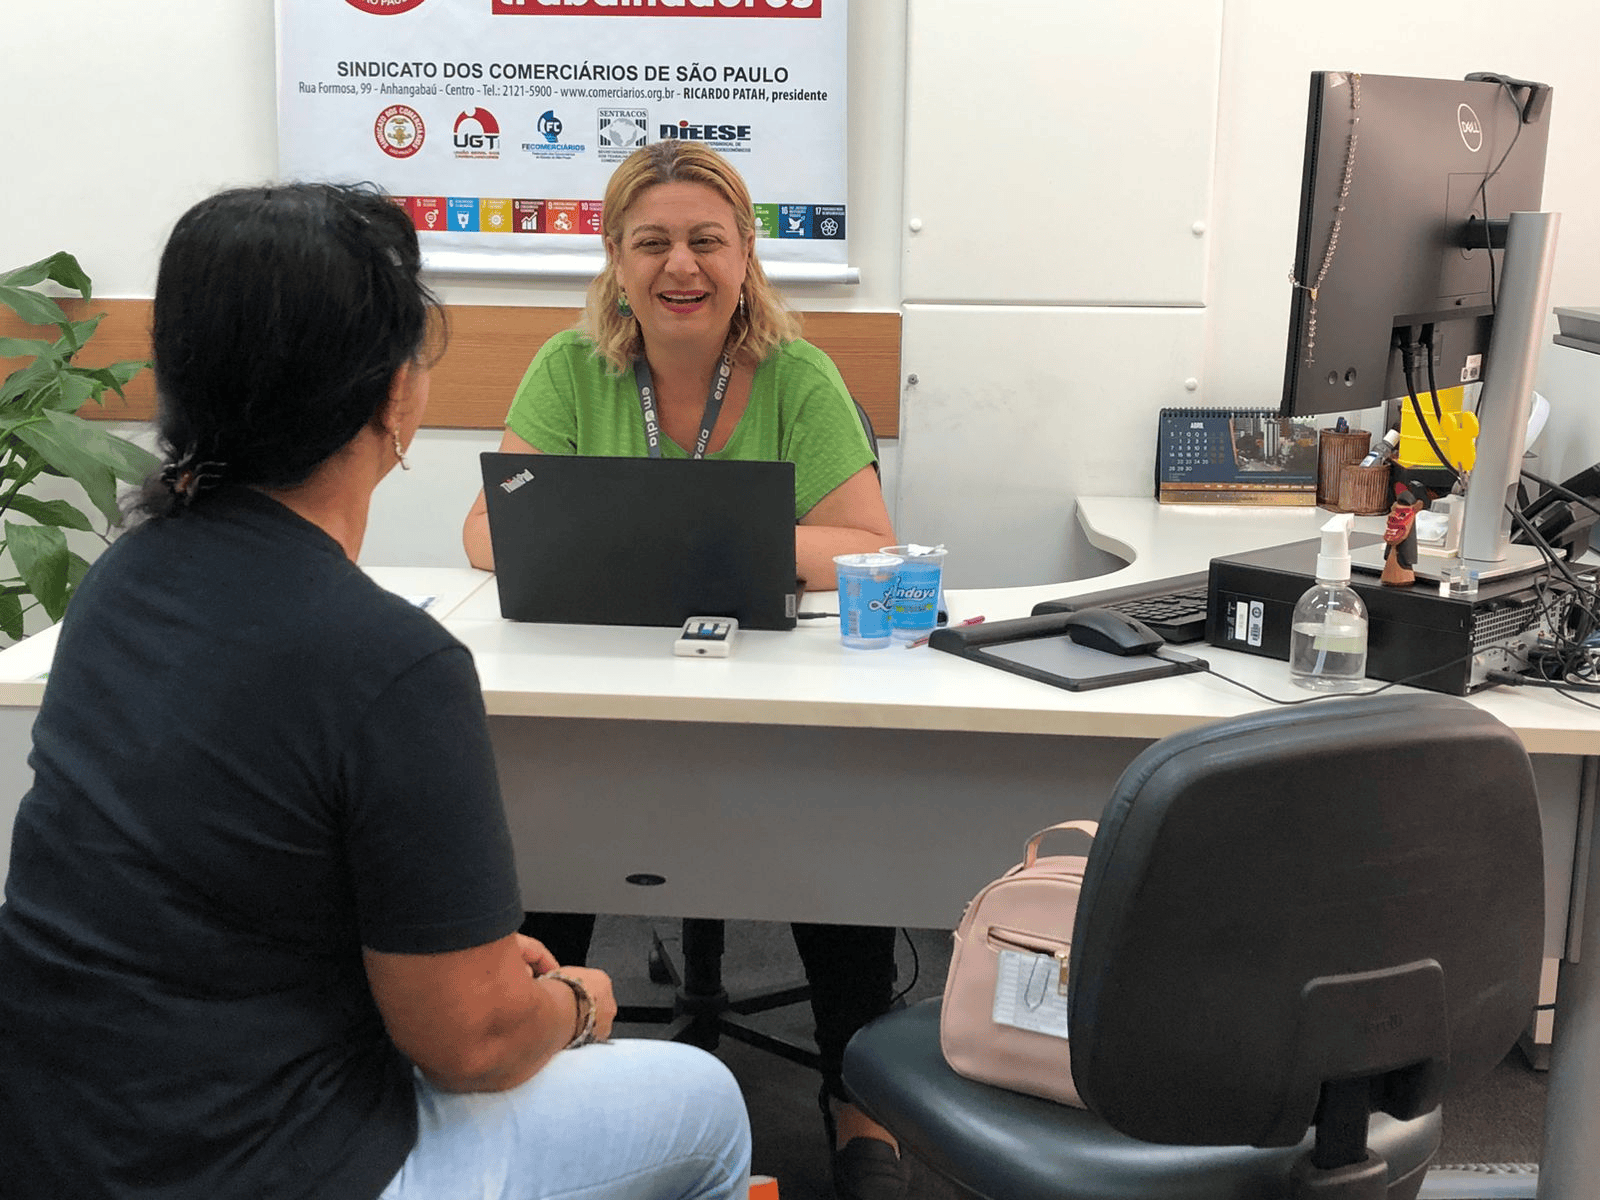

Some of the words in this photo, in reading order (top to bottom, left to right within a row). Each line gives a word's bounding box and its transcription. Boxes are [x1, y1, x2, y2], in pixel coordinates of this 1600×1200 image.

[337, 61, 437, 78] SINDICATO
[443, 62, 483, 79] DOS
[489, 61, 639, 81] COMERCIÁRIOS
[645, 66, 670, 81] DE
[676, 62, 717, 82] SÃO
[723, 67, 789, 83] PAULO
[298, 81, 316, 94] Rua
[318, 82, 359, 96] Formosa,
[360, 82, 372, 94] 99
[380, 82, 438, 98] Anhangabaú
[445, 83, 474, 96] Centro
[483, 84, 501, 96] Tel.:
[502, 84, 552, 97] 2121-5900
[560, 86, 675, 101] www.comerciarios.org.br
[683, 87, 730, 100] RICARDO
[732, 88, 769, 102] PATAH,
[772, 88, 828, 103] presidente
[599, 110, 647, 118] SENTRACOS
[1461, 121, 1480, 133] DELL
[453, 133, 499, 150] UGT
